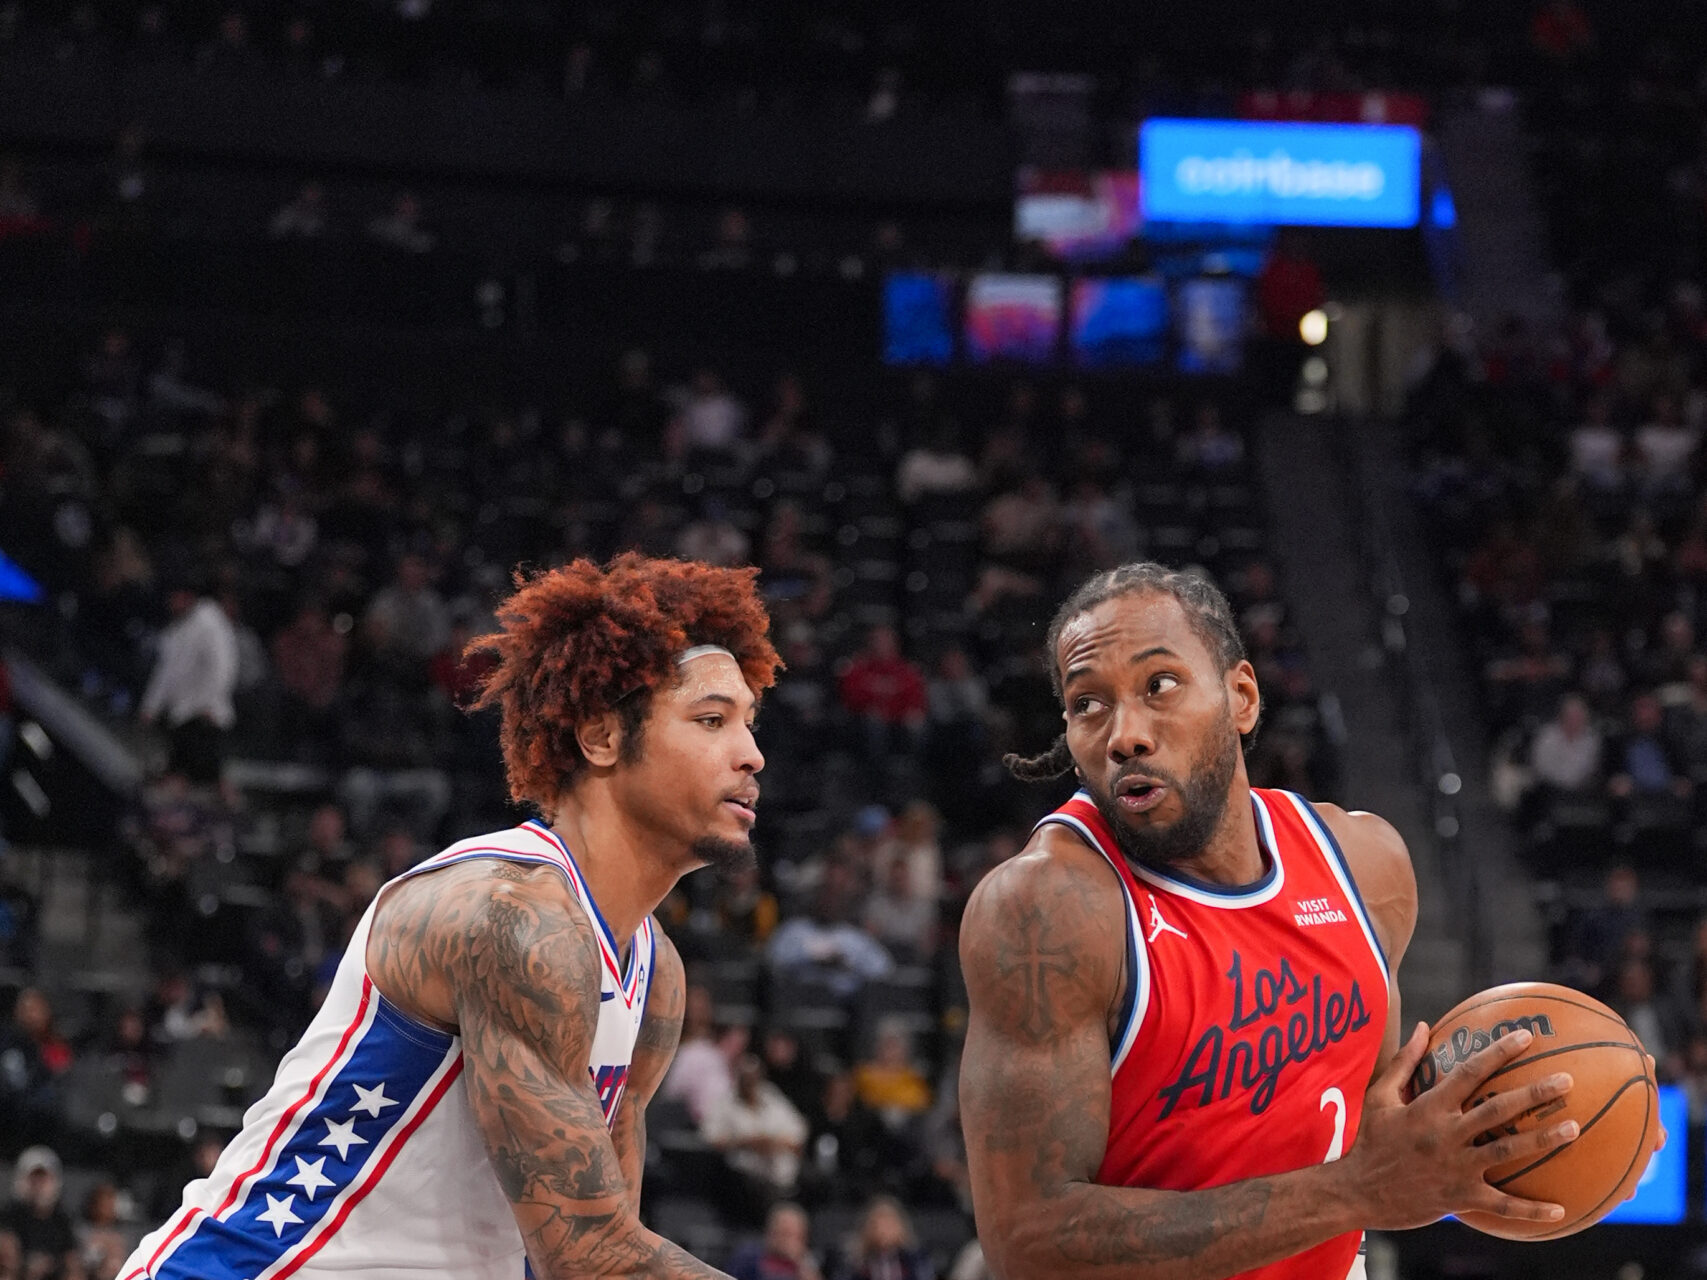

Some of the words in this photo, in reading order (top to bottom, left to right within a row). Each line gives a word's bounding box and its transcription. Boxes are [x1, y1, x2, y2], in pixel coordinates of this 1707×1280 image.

[1294, 910, 1348, 926] RWANDA
[1297, 898, 1330, 912] VISIT
[1226, 950, 1308, 1032] Los
[1156, 974, 1371, 1122] Angeles
